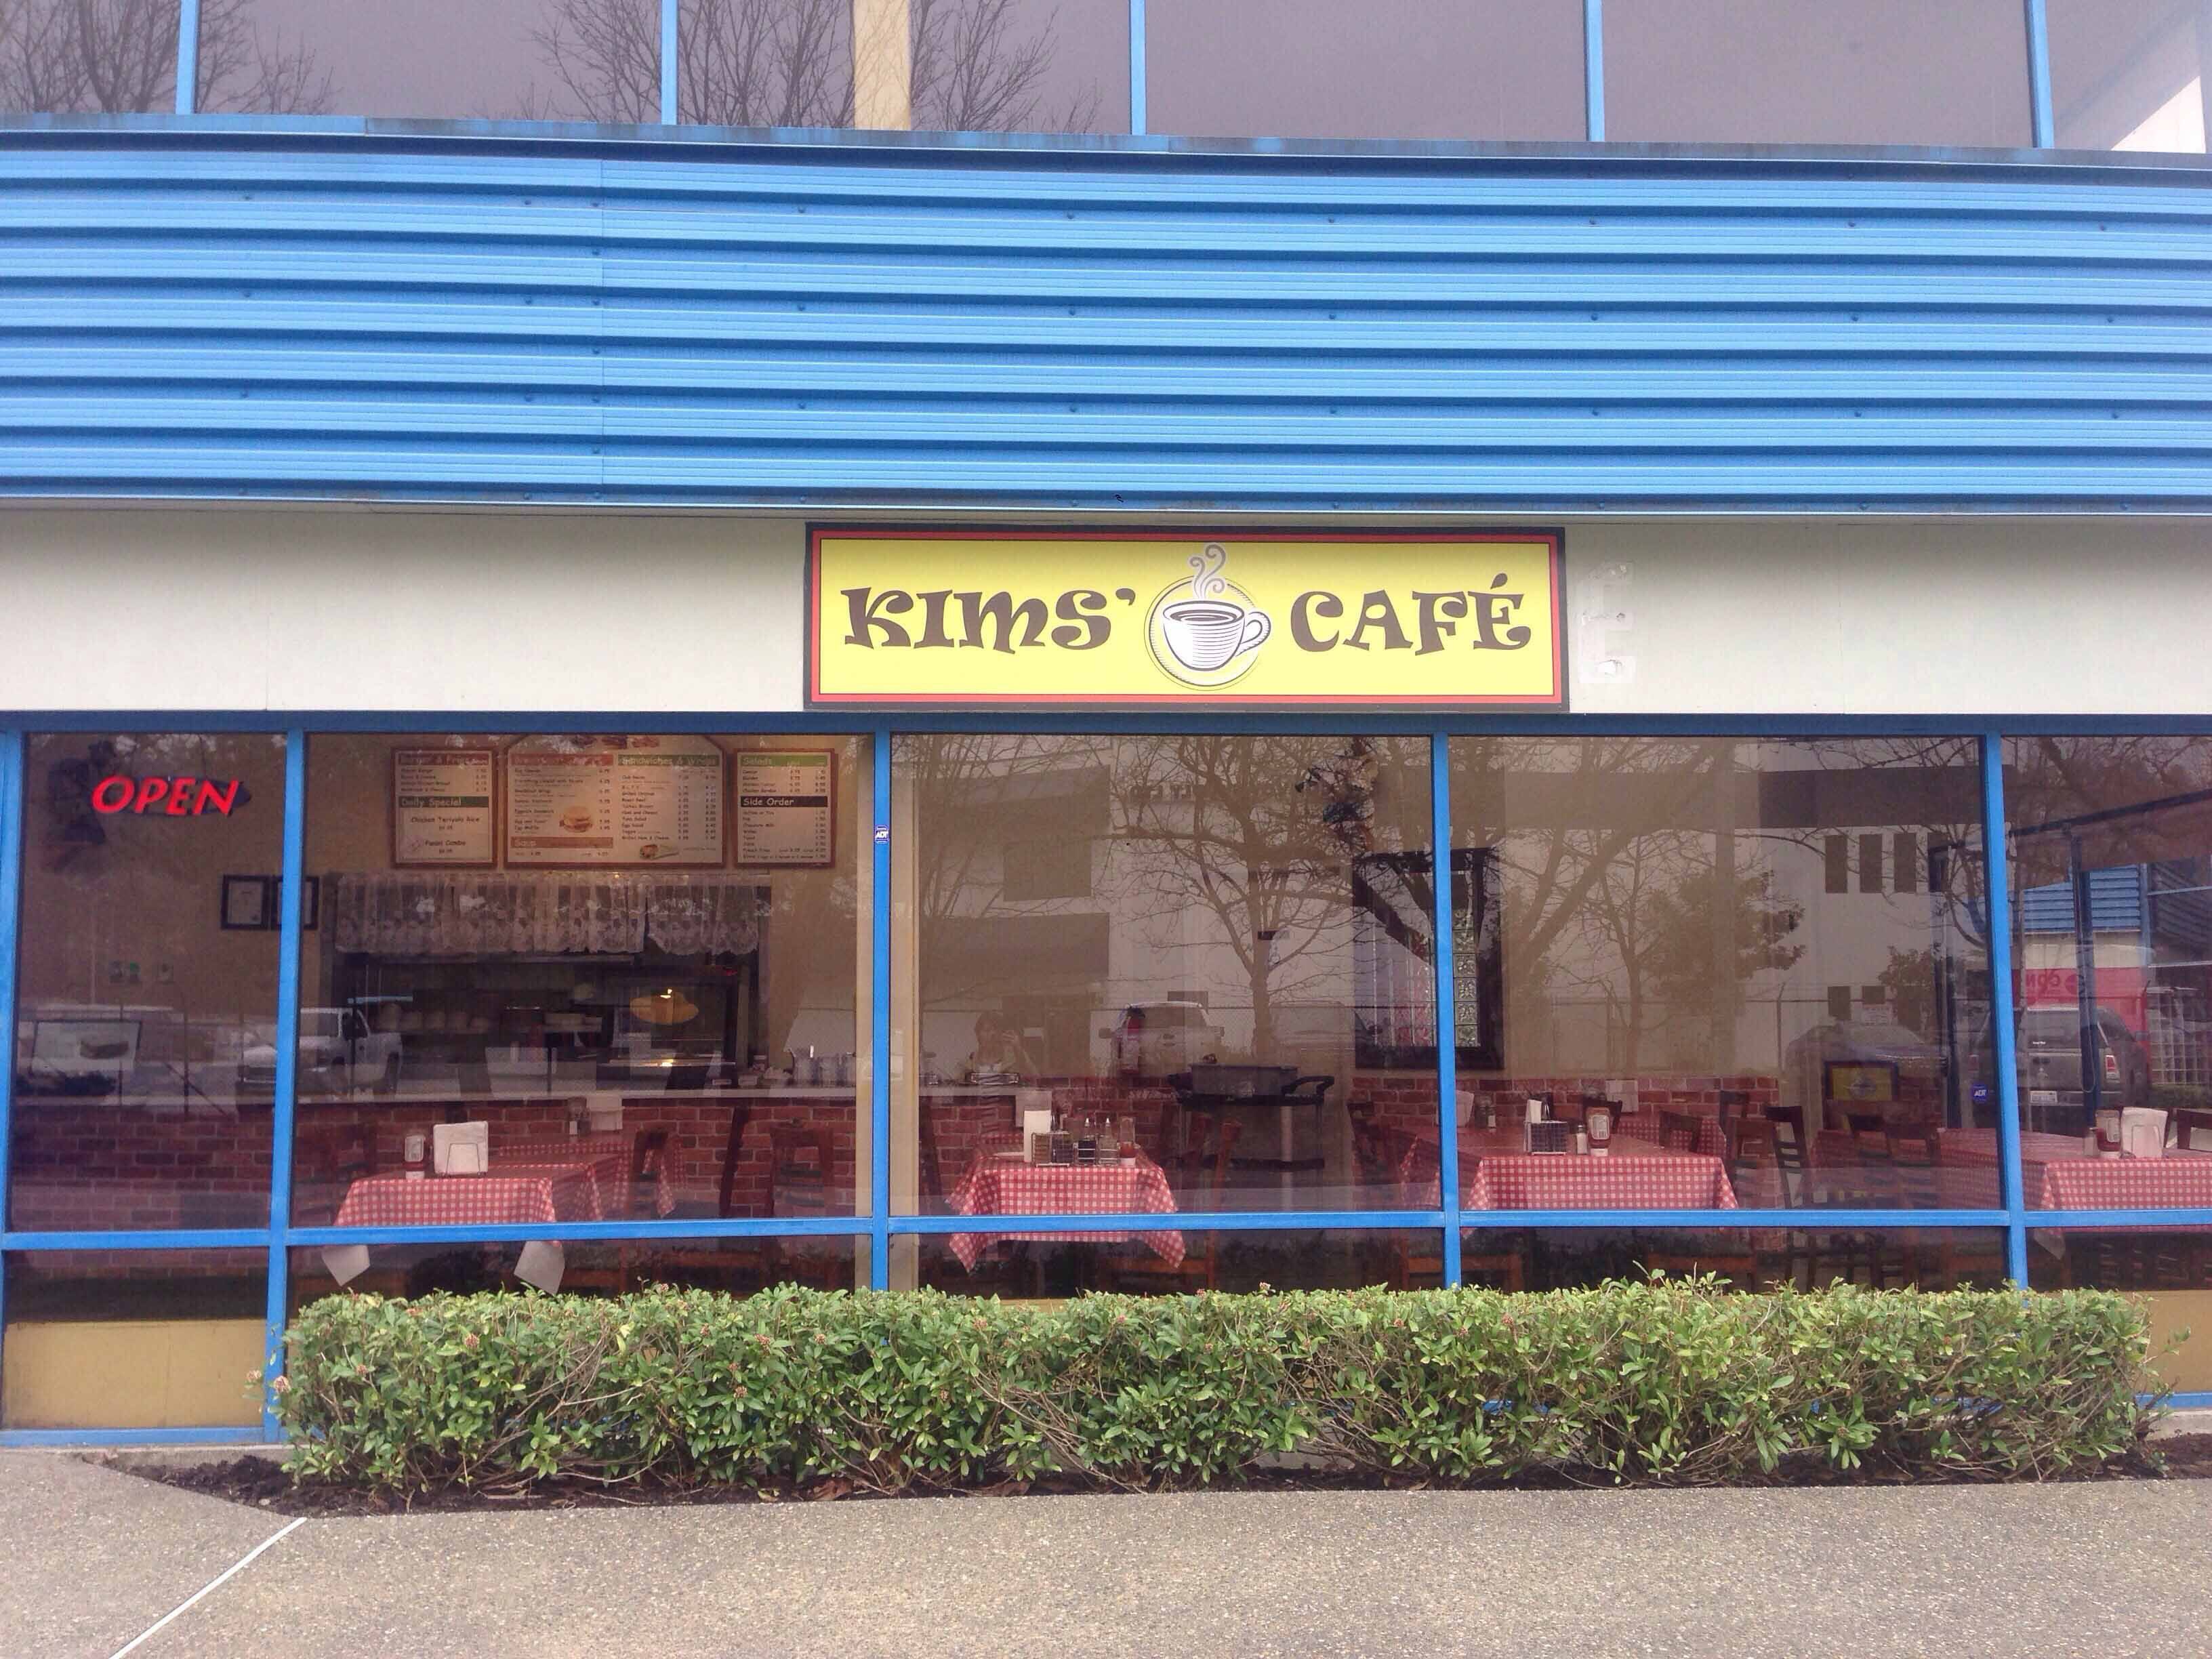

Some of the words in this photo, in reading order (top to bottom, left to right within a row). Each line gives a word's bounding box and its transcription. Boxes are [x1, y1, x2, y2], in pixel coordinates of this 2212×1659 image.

[1290, 573, 1532, 656] CAFÉ
[91, 774, 239, 817] OPEN
[402, 797, 423, 808] Daily
[428, 796, 461, 808] Special
[743, 798, 762, 806] Side
[766, 797, 794, 806] Order
